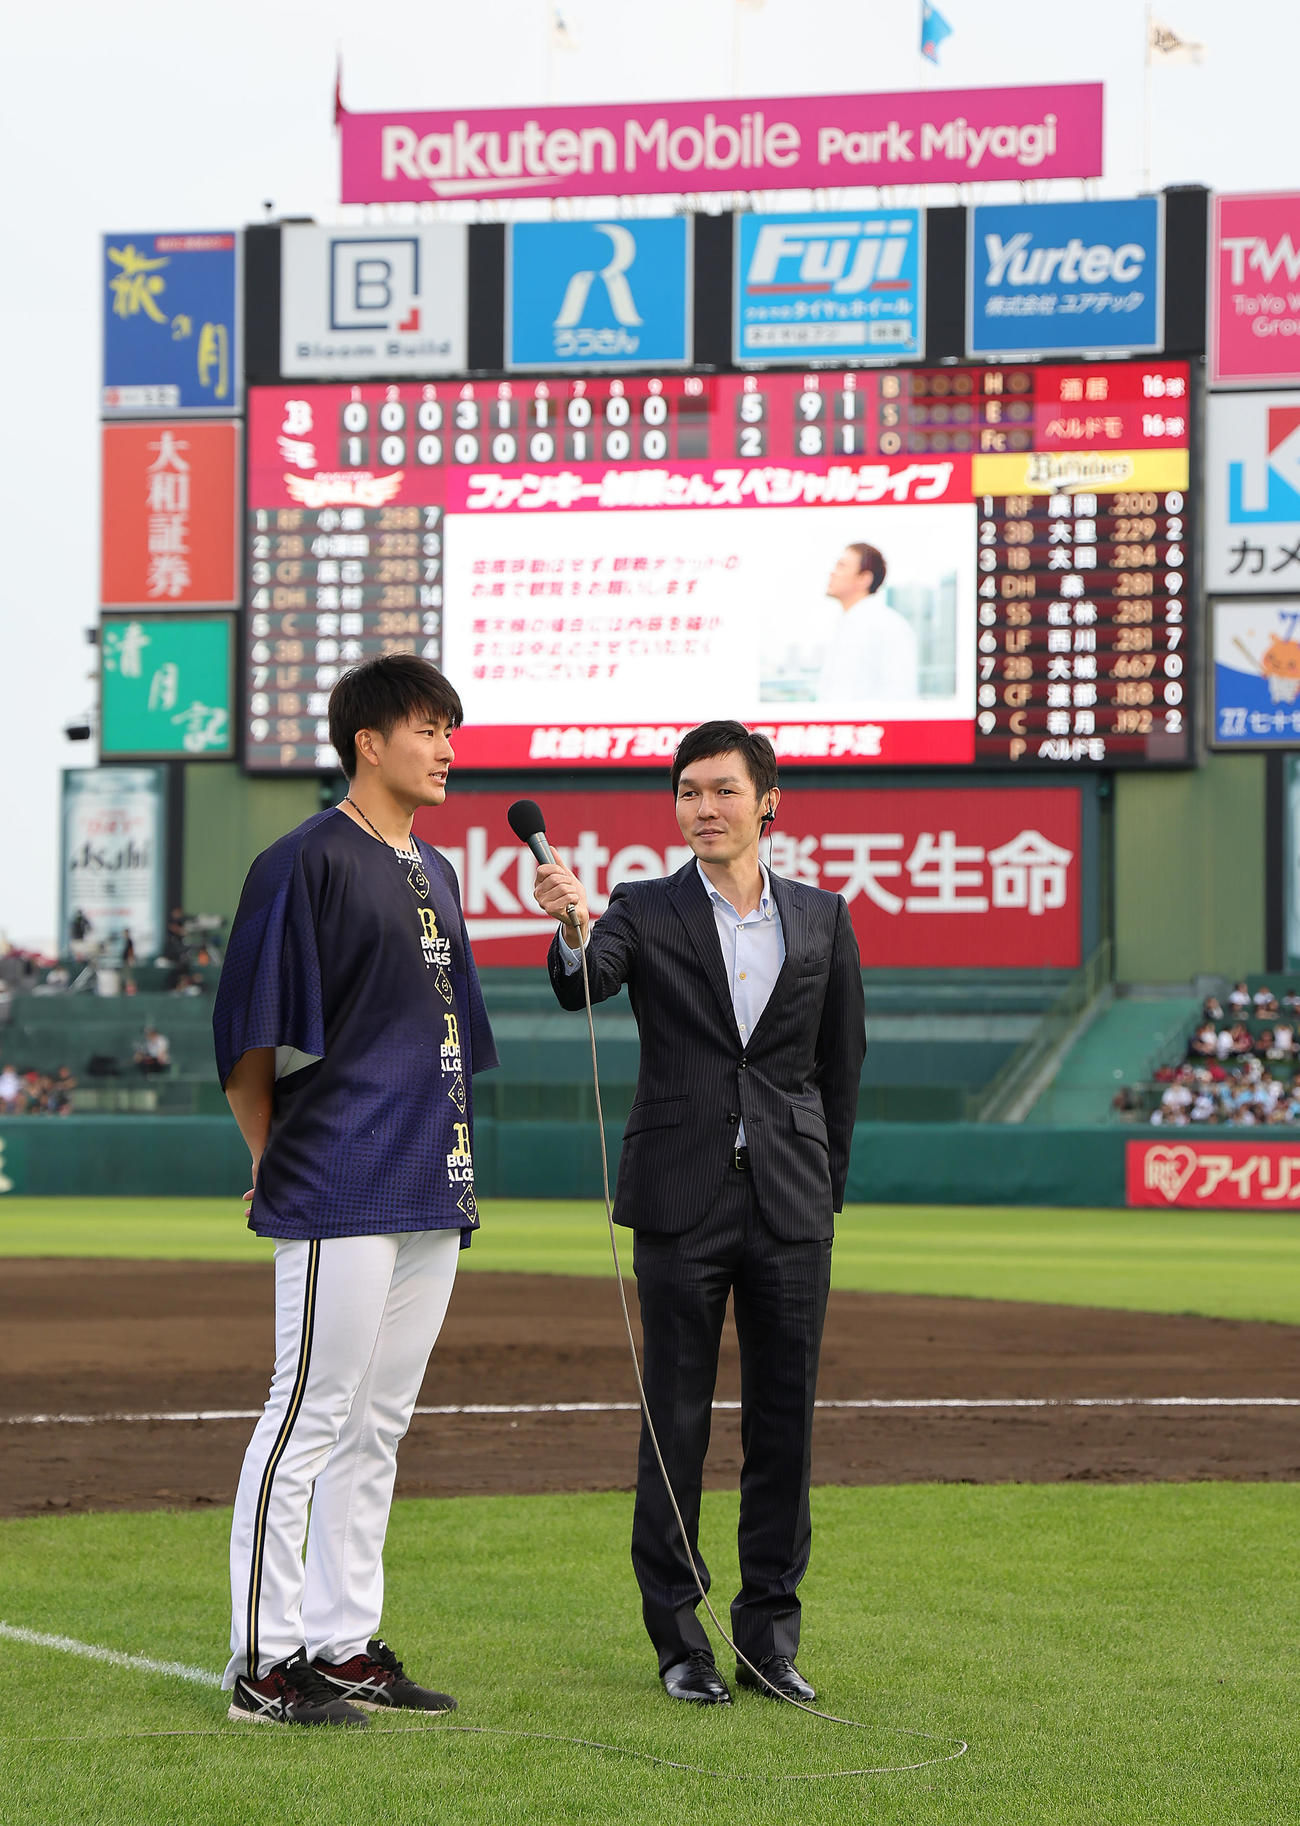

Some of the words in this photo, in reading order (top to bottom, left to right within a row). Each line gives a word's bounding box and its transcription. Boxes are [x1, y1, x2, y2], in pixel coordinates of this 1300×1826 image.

[382, 119, 617, 181] Rakuten
[624, 112, 801, 173] Mobile
[818, 120, 915, 166] Park
[920, 112, 1057, 168] Miyagi
[747, 219, 912, 295] Fuji
[984, 232, 1146, 287] Yurtec
[985, 293, 1058, 318] 株式会社
[1058, 290, 1145, 315] ユアテック
[296, 341, 376, 358] Bloom
[386, 340, 451, 356] Build
[386, 384, 400, 401] 2
[422, 384, 436, 401] 3
[460, 383, 474, 400] 4
[573, 380, 587, 397] 7
[648, 378, 663, 396] 9
[743, 375, 758, 393] R
[803, 374, 819, 391] H
[843, 373, 857, 391] E
[881, 375, 899, 398] B
[984, 371, 1003, 395] H
[343, 402, 368, 432] 0
[380, 401, 405, 432] 0
[418, 400, 443, 431] 0
[455, 400, 479, 430] 3
[497, 400, 510, 428] 1
[535, 399, 548, 428] 1
[567, 397, 592, 428] 0
[606, 396, 630, 426] 0
[643, 395, 667, 425] 0
[740, 393, 763, 423] 5
[799, 391, 822, 421] 9
[842, 390, 855, 420] 1
[882, 403, 898, 427] S
[985, 400, 1002, 424] E
[347, 436, 362, 466] 1
[380, 435, 405, 466] 0
[417, 434, 442, 465] 0
[454, 434, 479, 465] 0
[492, 433, 516, 464] 0
[530, 432, 554, 463] 0
[572, 430, 586, 461] 1
[606, 429, 630, 460] 0
[643, 429, 667, 460] 0
[740, 427, 762, 457] 2
[799, 425, 822, 455] 8
[841, 424, 855, 454] 1
[147, 430, 191, 598] 大和証券
[983, 494, 994, 518] 1
[1165, 490, 1184, 515] 0
[256, 509, 268, 532] 1
[423, 506, 440, 529] 7
[979, 520, 997, 545] 2
[1165, 517, 1184, 542] 2
[253, 535, 271, 559] 2
[422, 533, 441, 557] 3
[979, 548, 997, 572] 3
[1165, 543, 1184, 568] 6
[252, 561, 271, 585] 3
[423, 558, 440, 582] 7
[979, 575, 997, 599] 4
[1001, 574, 1036, 598] DH
[1164, 571, 1183, 596] 9
[252, 587, 270, 610] 4
[281, 613, 297, 636] C
[422, 611, 440, 635] 2
[979, 602, 997, 626] 5
[1005, 602, 1032, 626] SS
[1165, 599, 1183, 624] 2
[252, 640, 271, 663] 6
[422, 638, 440, 659] 4
[978, 629, 997, 653] 6
[1005, 629, 1032, 653] LF
[1165, 626, 1183, 651] 7
[252, 665, 269, 689] 7
[979, 656, 996, 680] 7
[1109, 654, 1157, 679] .667
[1164, 653, 1183, 678] 0
[251, 692, 270, 716] 8
[978, 683, 997, 708] 8
[1004, 683, 1032, 708] CF
[1164, 681, 1183, 706] 0
[250, 718, 270, 742] 9
[978, 711, 996, 735] 9
[1009, 710, 1028, 735] C
[1165, 708, 1183, 733] 2
[1009, 737, 1027, 761] P
